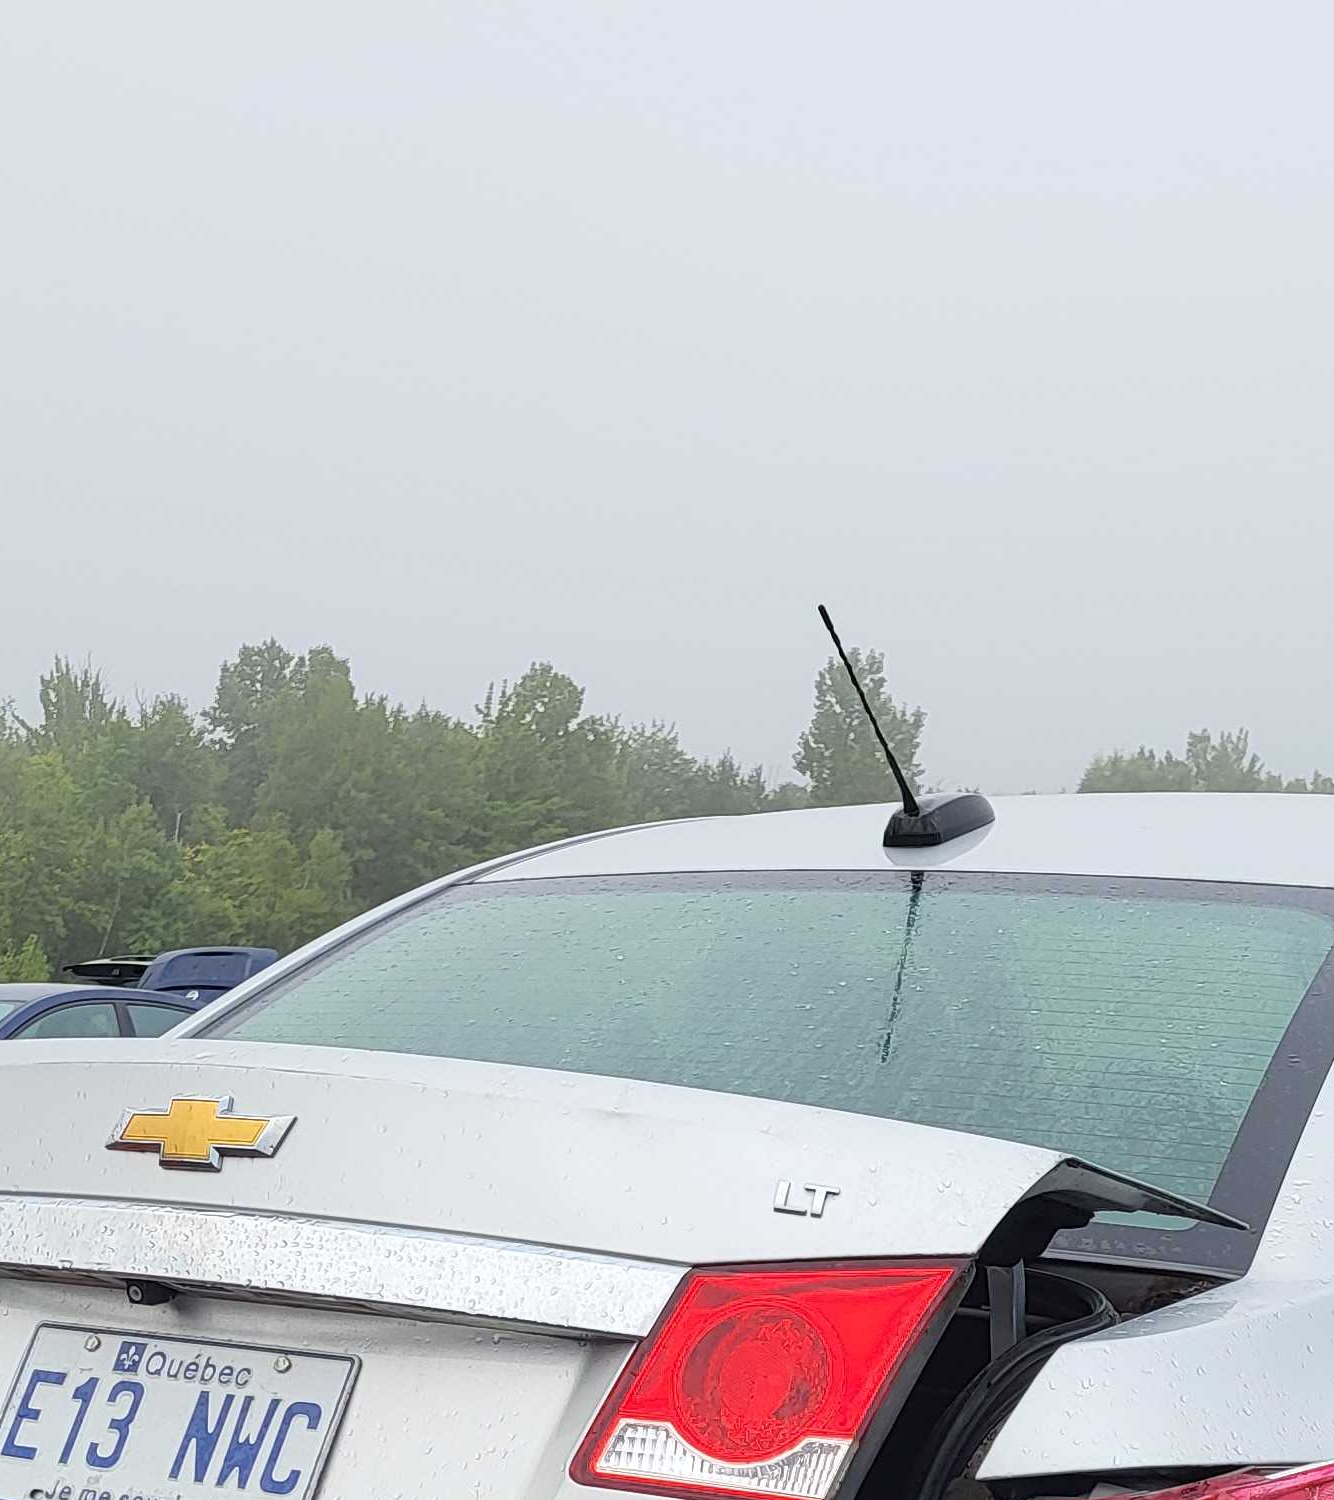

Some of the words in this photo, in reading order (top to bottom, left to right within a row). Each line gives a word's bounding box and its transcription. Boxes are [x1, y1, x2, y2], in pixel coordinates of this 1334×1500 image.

[772, 1180, 841, 1219] LT
[145, 1350, 253, 1389] Québec
[0, 1368, 146, 1469] E13
[167, 1389, 323, 1496] NWC
[44, 1482, 72, 1500] Je
